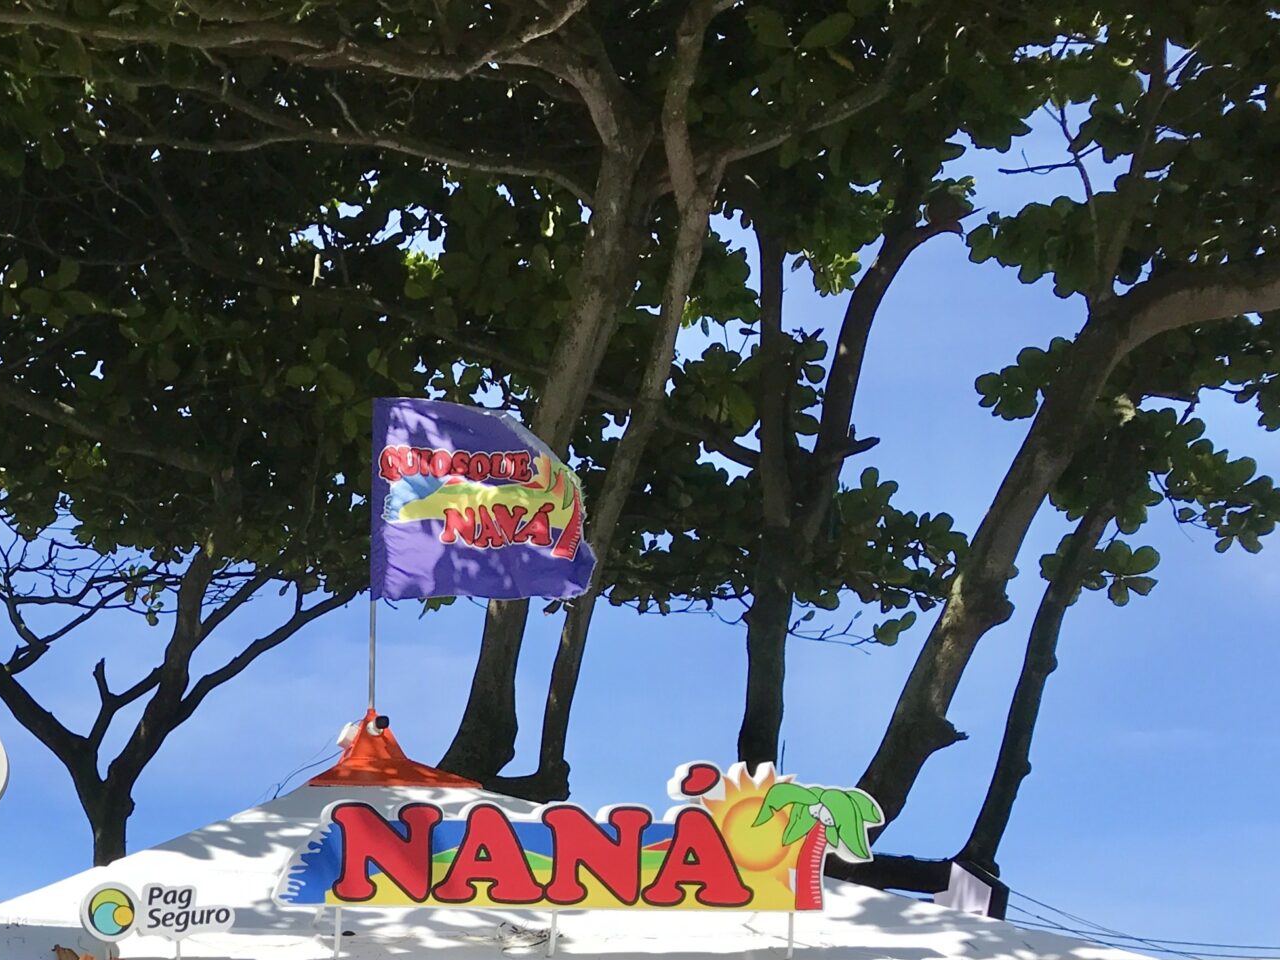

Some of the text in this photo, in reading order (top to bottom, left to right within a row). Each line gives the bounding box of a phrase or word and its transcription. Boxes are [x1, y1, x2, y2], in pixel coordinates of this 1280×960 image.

[380, 446, 533, 481] QUIOSQUE
[332, 763, 753, 907] NANÁ
[148, 887, 192, 909] Pag
[147, 908, 230, 932] Seguro
